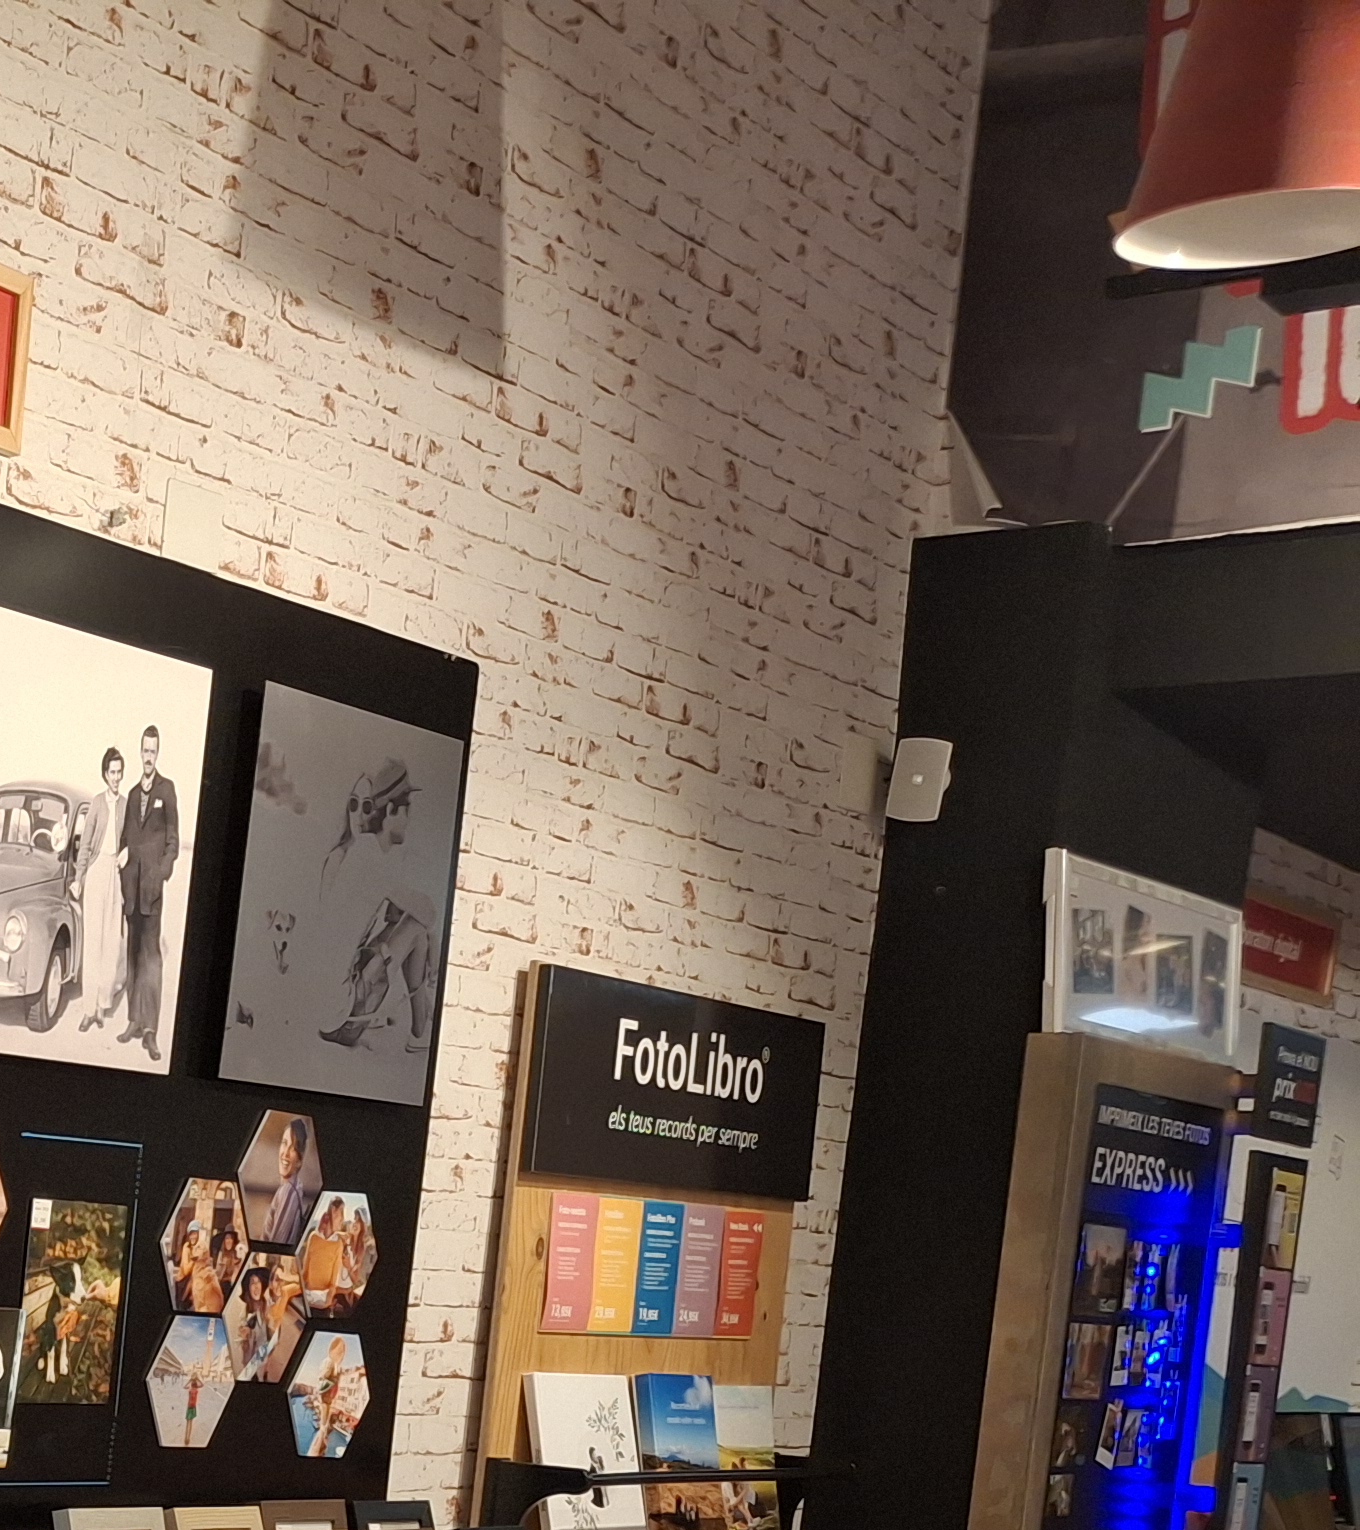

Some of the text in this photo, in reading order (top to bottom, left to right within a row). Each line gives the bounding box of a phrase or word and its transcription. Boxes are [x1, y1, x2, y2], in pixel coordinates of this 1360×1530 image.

[613, 1017, 765, 1104] FotoLibro
[608, 1105, 759, 1153] els teus records per sempre
[1091, 1147, 1165, 1193] EXPRESS
